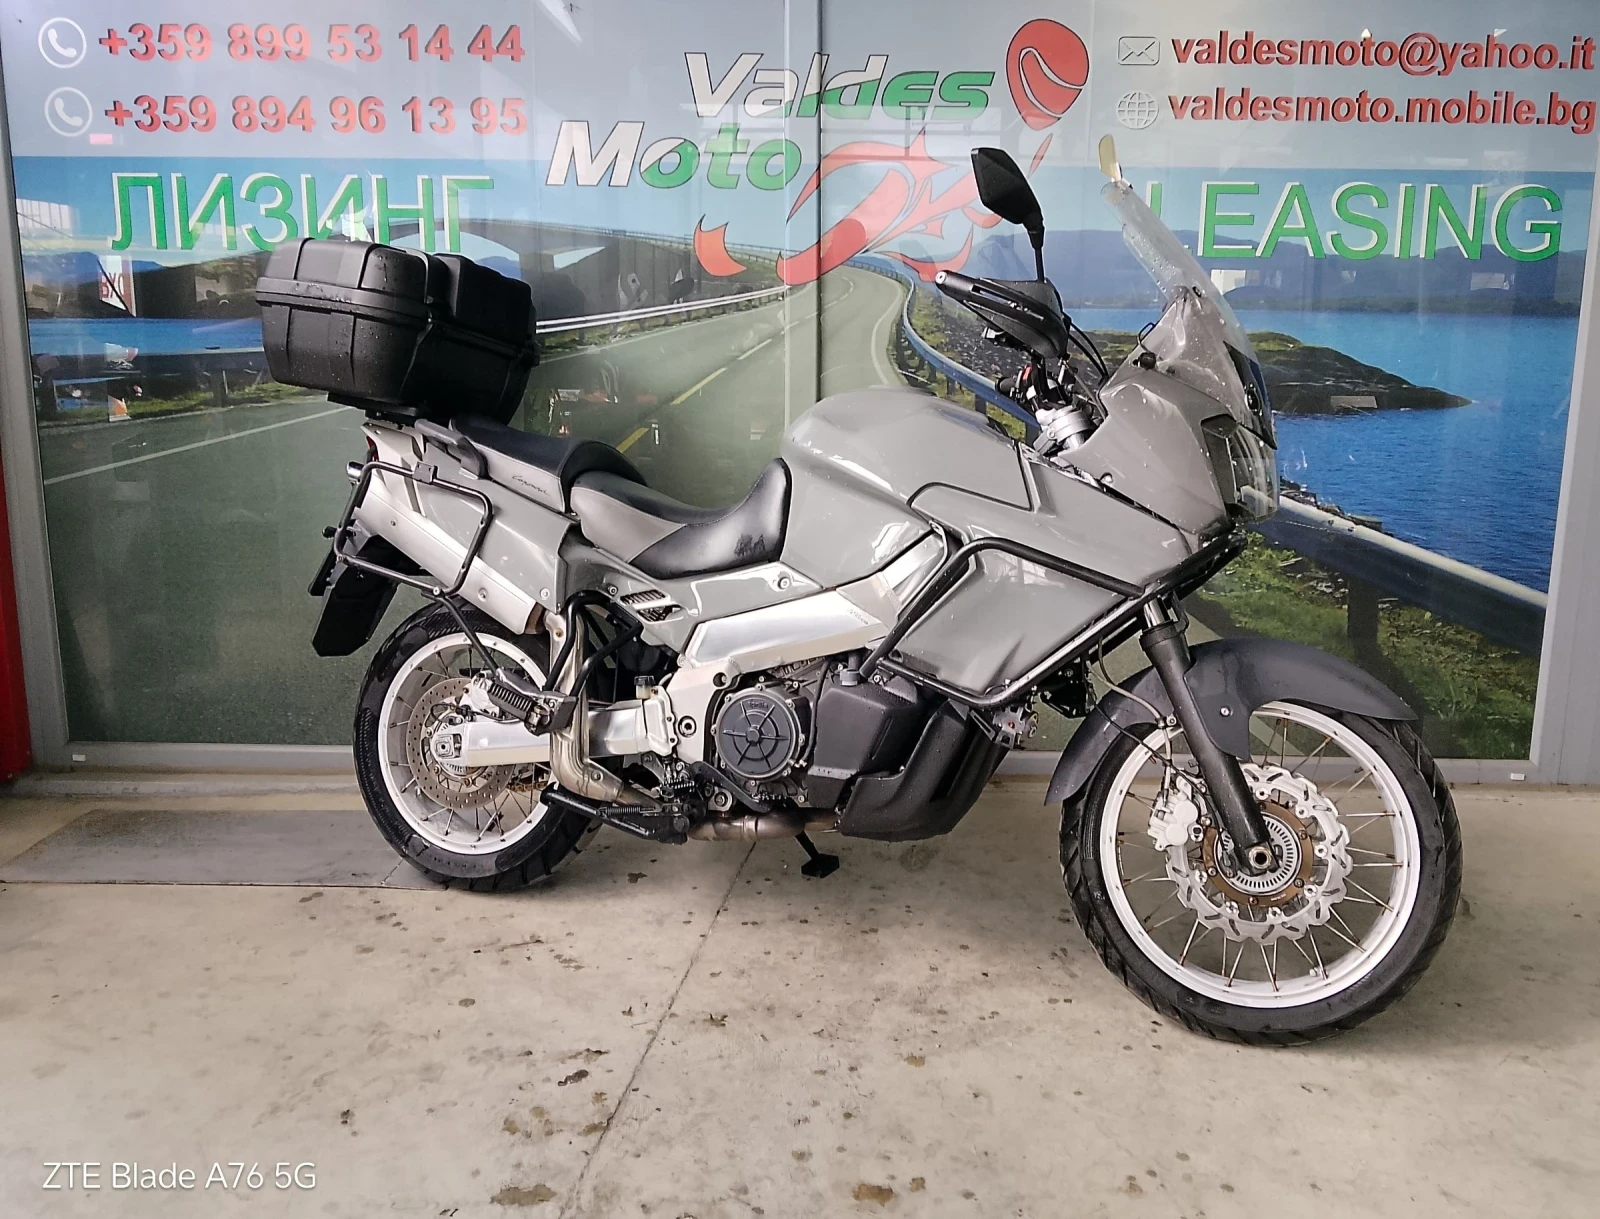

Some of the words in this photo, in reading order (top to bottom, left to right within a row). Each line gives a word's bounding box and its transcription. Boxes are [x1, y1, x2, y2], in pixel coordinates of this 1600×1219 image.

[99, 23, 213, 62] +359
[227, 23, 312, 62] 899
[327, 23, 383, 63] 53
[398, 23, 455, 63] 14
[467, 24, 526, 63] 44
[1171, 30, 1597, 76] valdesmoto@yahoo.it
[684, 52, 996, 120] Valdes
[104, 95, 217, 133] +359
[231, 95, 316, 133] 894
[329, 95, 387, 134] 96
[401, 96, 457, 134] 13
[469, 97, 528, 135] 95
[1168, 87, 1597, 135] valdesmoto.mobile.bg
[545, 120, 802, 190] Moto
[107, 172, 495, 252] ЛИЗИНГ
